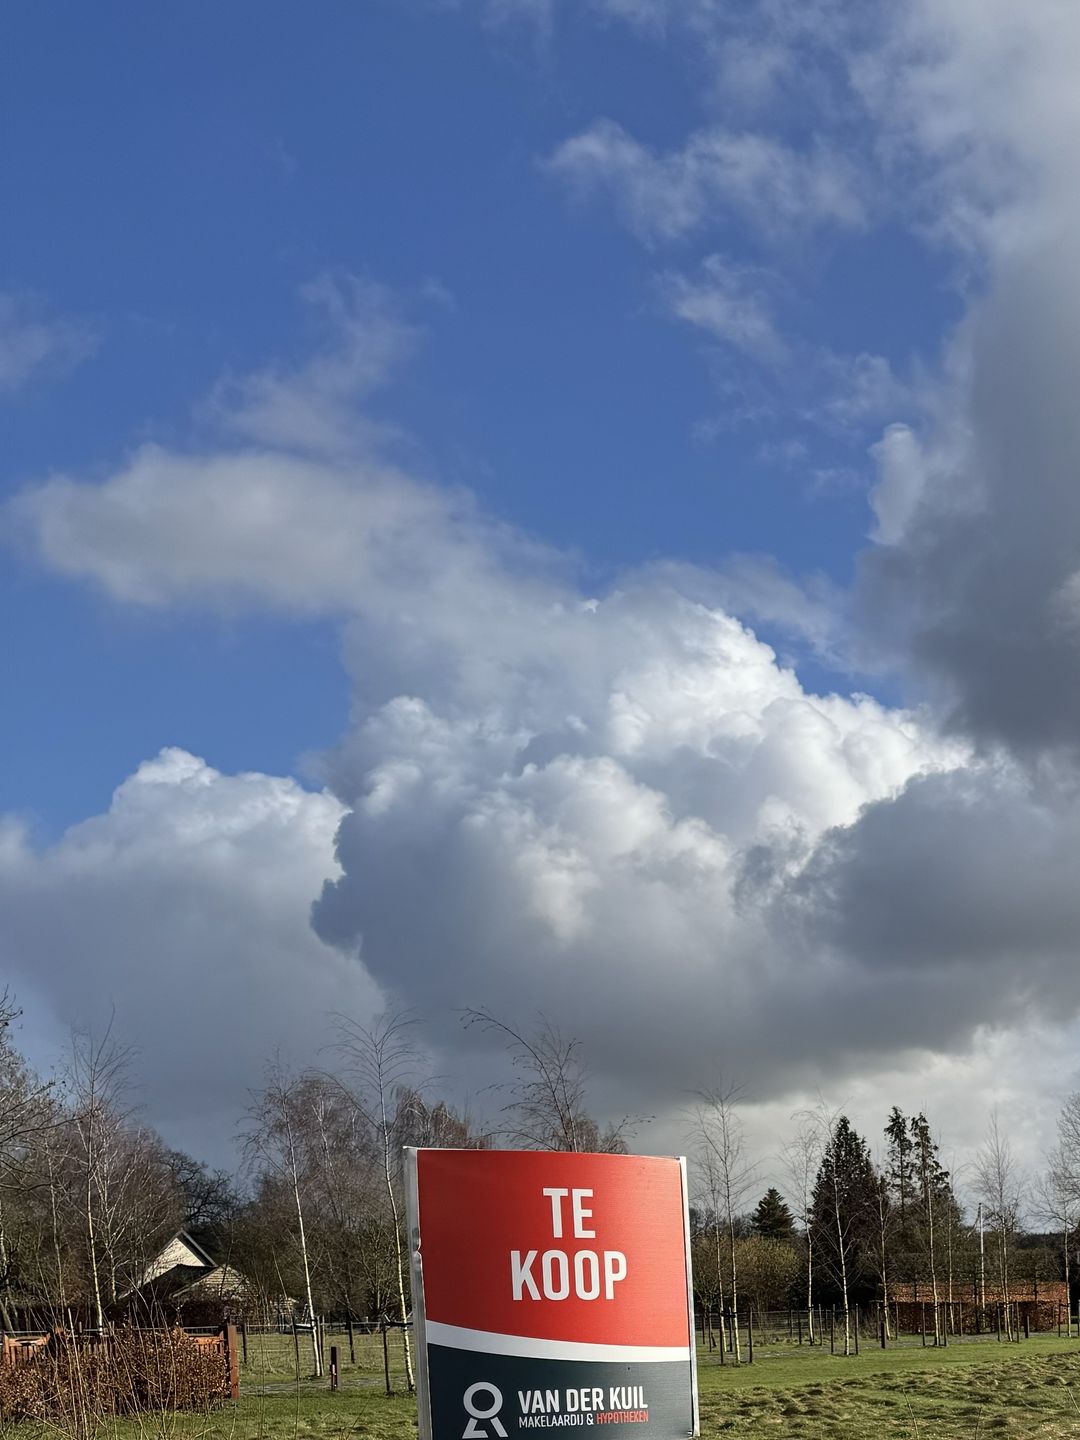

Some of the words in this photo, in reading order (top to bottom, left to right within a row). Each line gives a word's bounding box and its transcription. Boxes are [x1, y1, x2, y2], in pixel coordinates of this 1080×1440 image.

[543, 1187, 596, 1239] TE
[510, 1250, 627, 1301] KOOP
[518, 1389, 560, 1414] VAN
[566, 1387, 604, 1412] DER
[609, 1386, 648, 1410] KUIL
[518, 1414, 584, 1428] MAKELAARDIJ
[586, 1413, 594, 1425] &
[596, 1411, 649, 1424] HYPOTHEKEN
